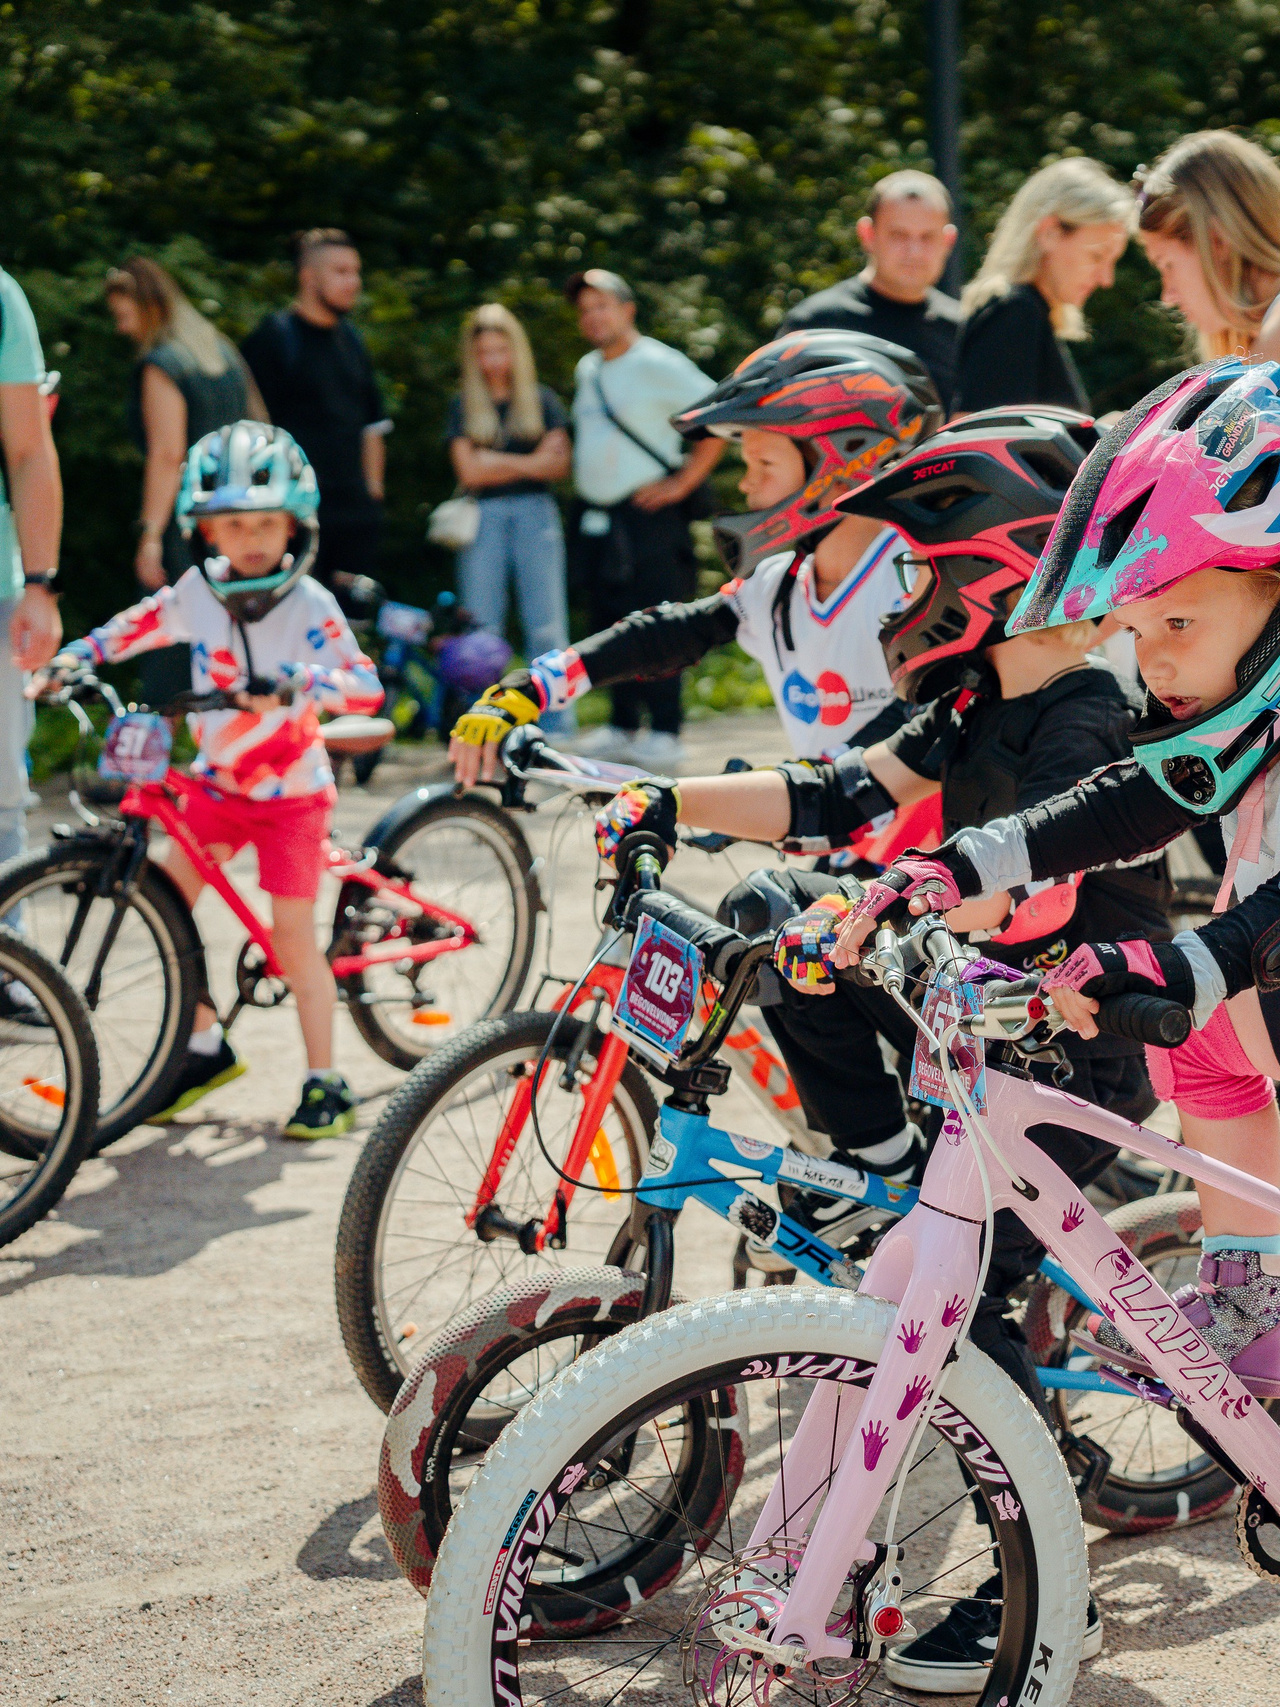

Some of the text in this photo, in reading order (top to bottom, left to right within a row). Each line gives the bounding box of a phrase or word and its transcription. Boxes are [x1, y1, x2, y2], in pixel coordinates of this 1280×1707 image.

[1222, 422, 1243, 457] GRAND
[912, 459, 957, 481] JETCAT
[1209, 449, 1251, 496] JETCAT
[645, 951, 685, 1004] 103
[1109, 1274, 1230, 1401] LAPA
[774, 1354, 877, 1381] APA
[485, 1549, 508, 1613] KENDA
